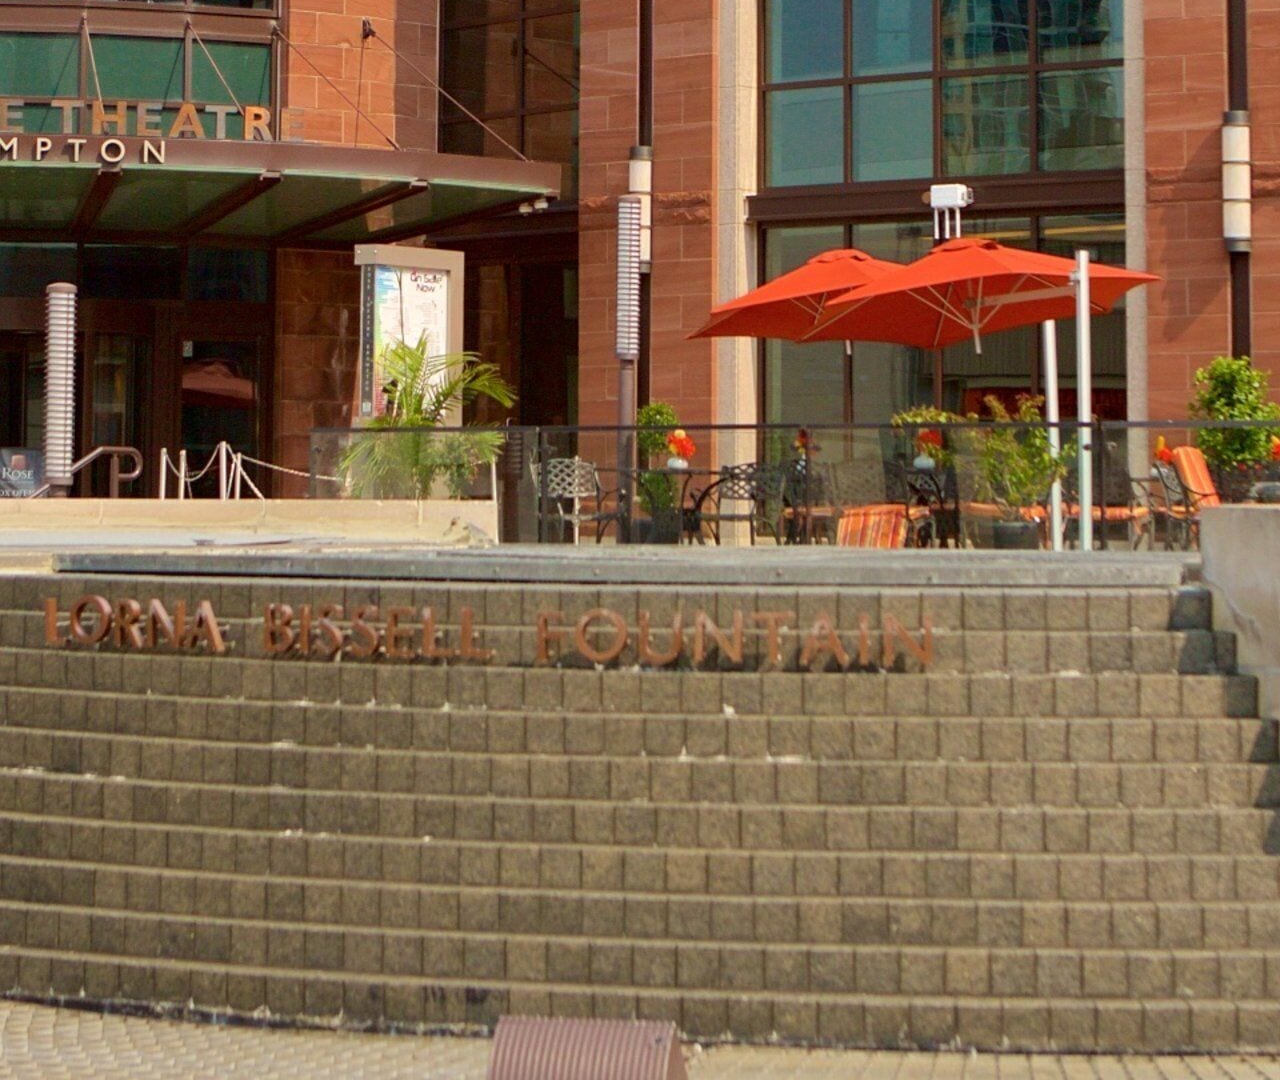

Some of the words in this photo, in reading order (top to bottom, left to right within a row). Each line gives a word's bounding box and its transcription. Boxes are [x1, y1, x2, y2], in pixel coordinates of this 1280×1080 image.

[51, 99, 306, 143] THEATRE
[44, 595, 227, 653] LORNA
[263, 603, 496, 658] BISSELL
[536, 606, 934, 668] FOUNTAIN
